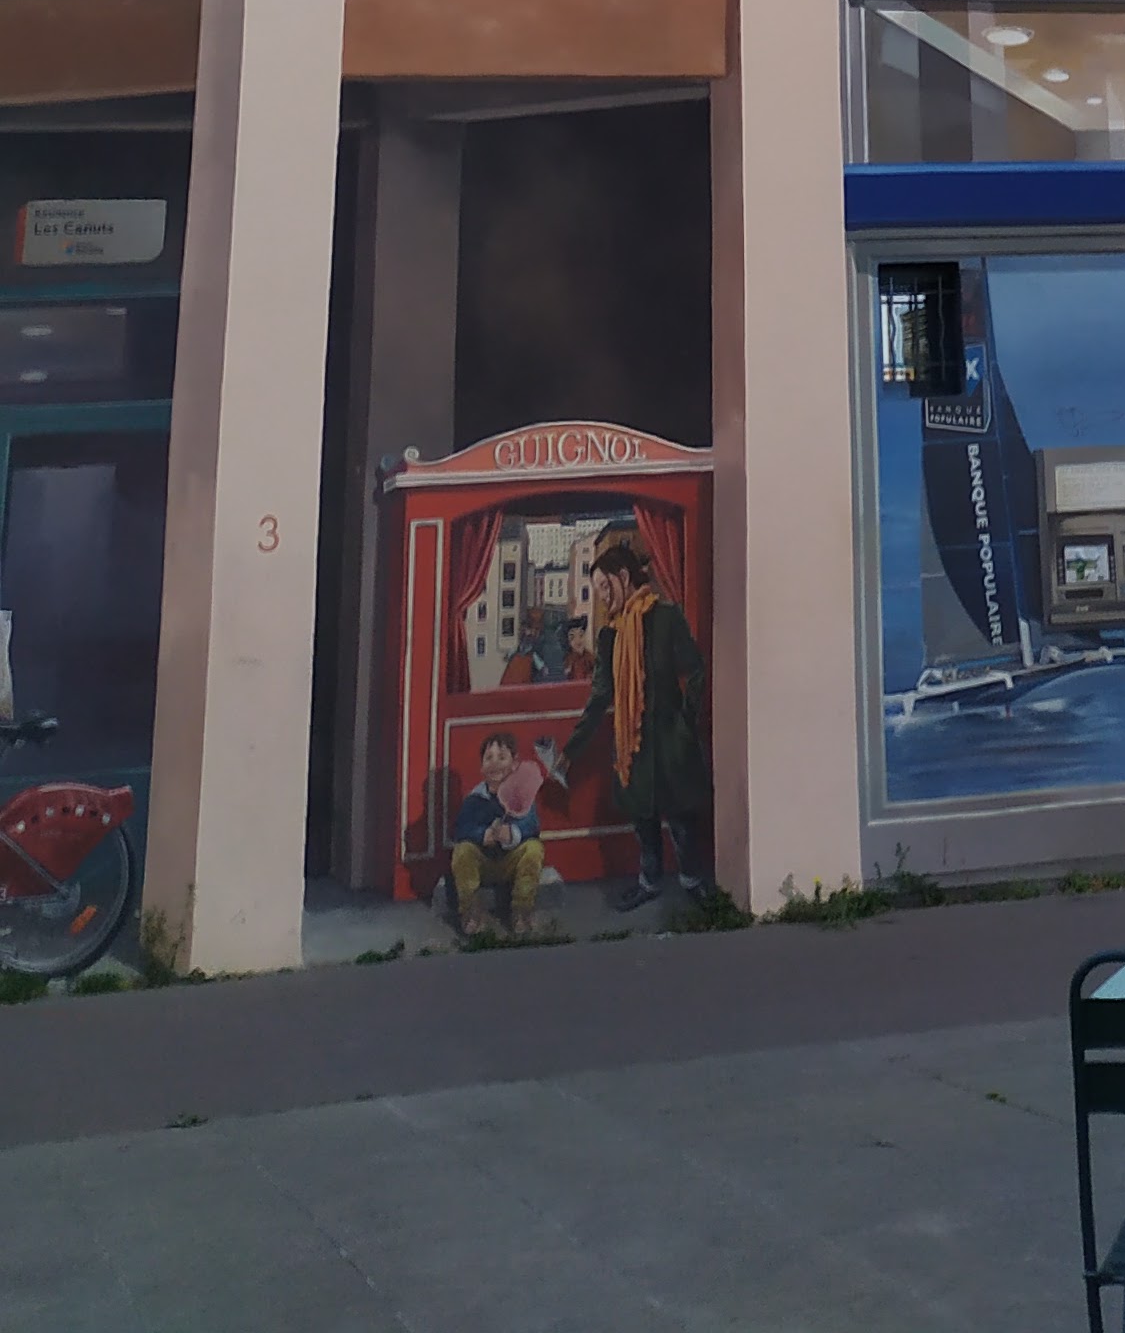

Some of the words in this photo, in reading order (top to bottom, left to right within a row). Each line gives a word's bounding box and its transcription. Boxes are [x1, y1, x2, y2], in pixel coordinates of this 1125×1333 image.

[929, 415, 982, 427] POPULAIRE
[494, 430, 647, 471] GUIGNOL
[258, 514, 280, 553] 3
[967, 443, 989, 529] BANQUE
[978, 533, 1003, 647] POPULAIRE
